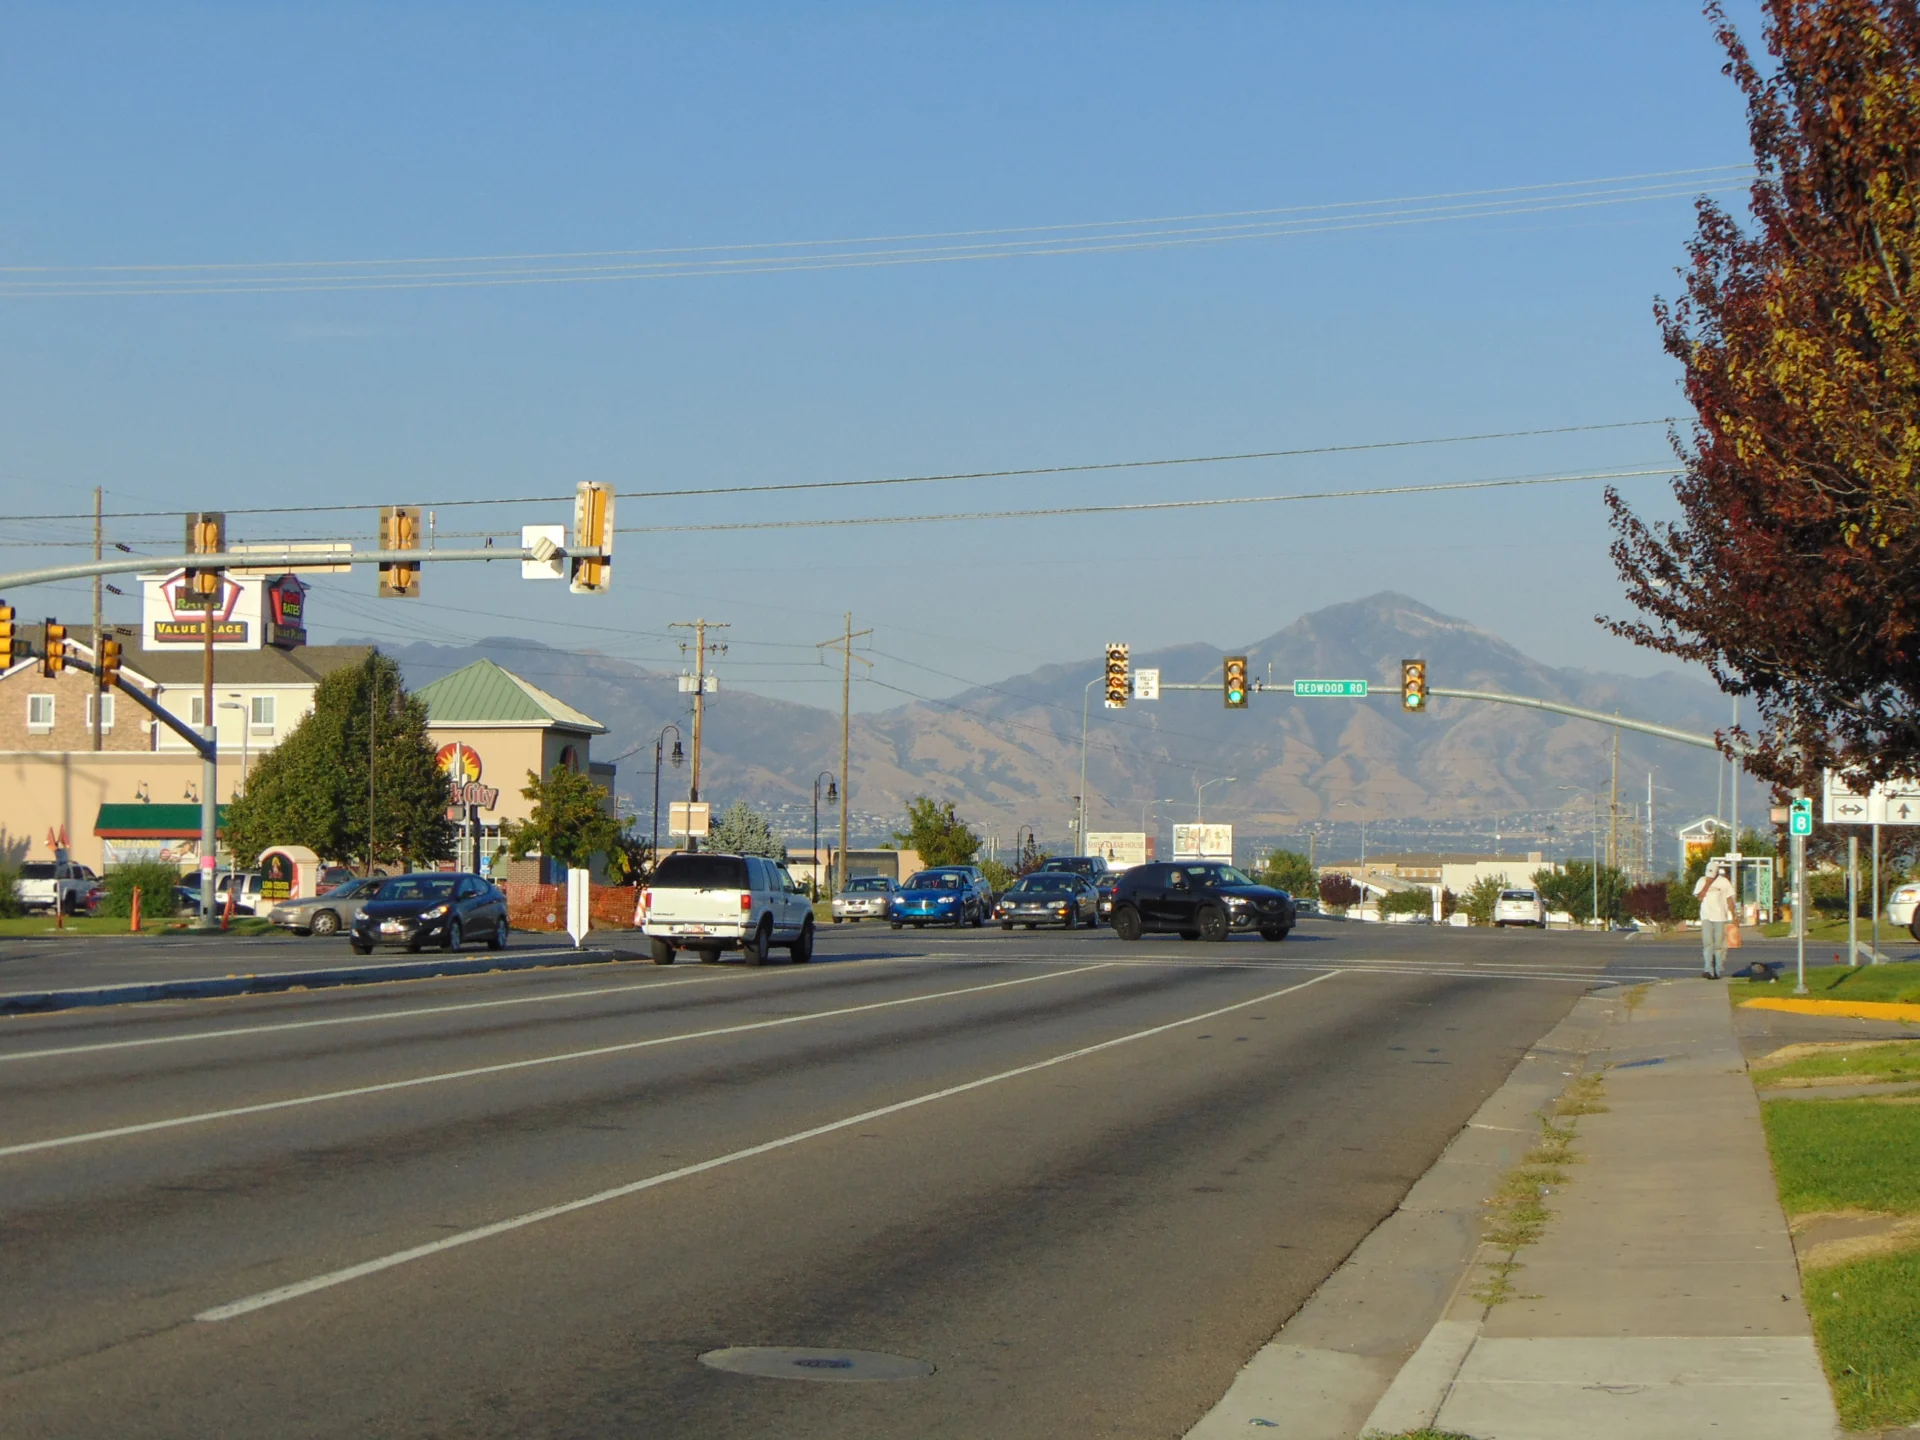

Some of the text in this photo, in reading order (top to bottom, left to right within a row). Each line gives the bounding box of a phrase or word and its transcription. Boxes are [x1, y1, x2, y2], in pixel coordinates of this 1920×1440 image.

[282, 602, 300, 616] RATES
[157, 622, 242, 633] VALUE PACE
[1298, 683, 1344, 693] REDWOOD
[465, 781, 498, 810] City
[1796, 816, 1807, 831] 8
[1123, 841, 1144, 849] HOUSE
